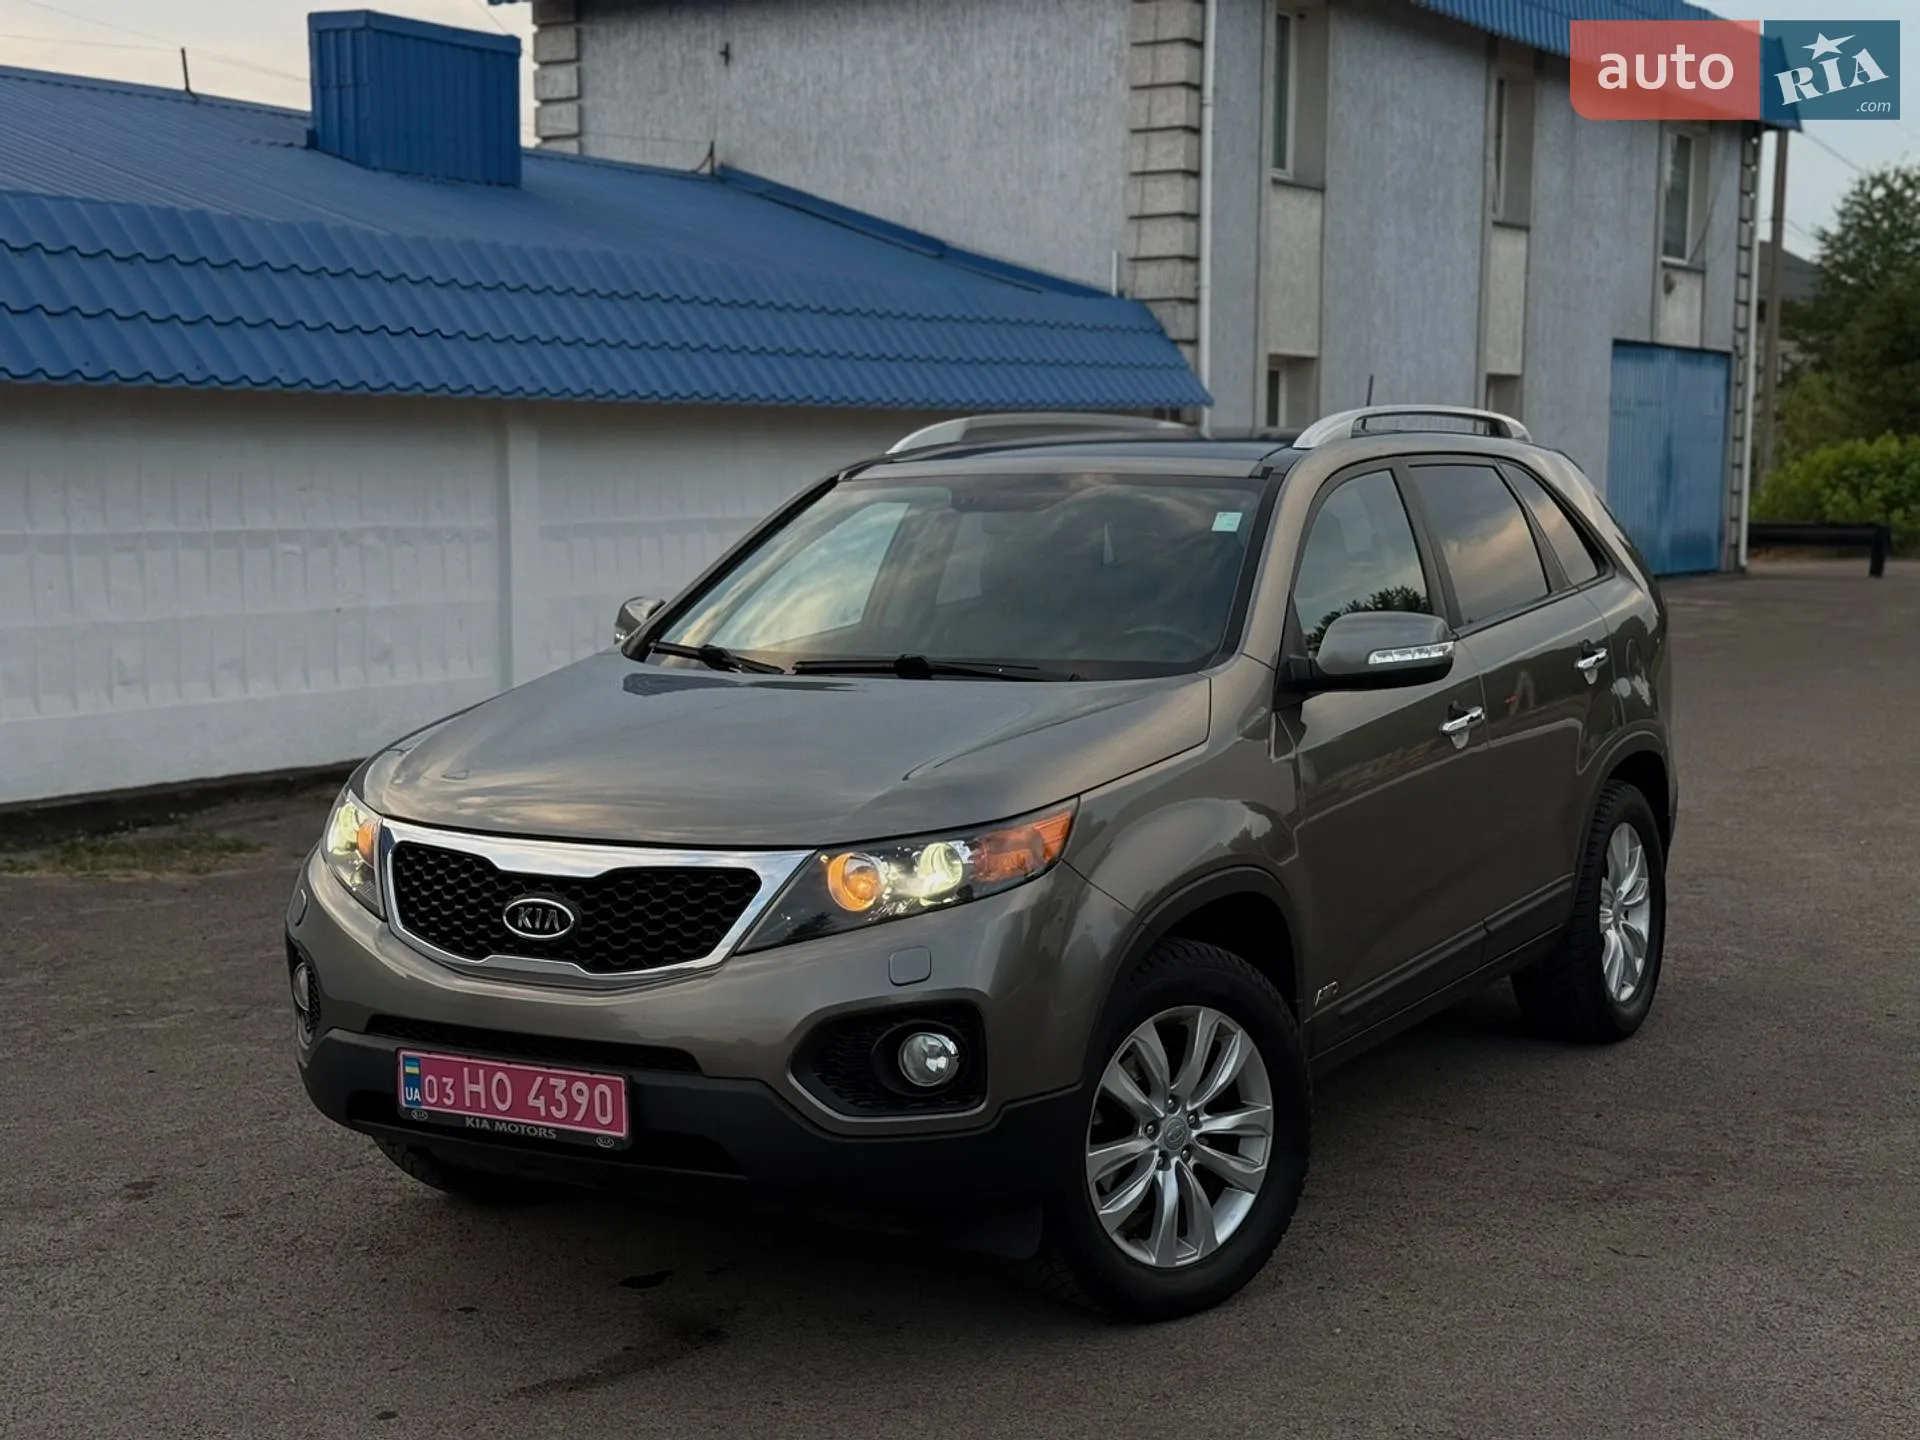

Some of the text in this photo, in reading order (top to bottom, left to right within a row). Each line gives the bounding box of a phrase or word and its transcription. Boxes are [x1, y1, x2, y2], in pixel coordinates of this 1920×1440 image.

[518, 906, 560, 931] KIA
[404, 1087, 421, 1102] UA
[424, 1074, 455, 1106] 03
[527, 1076, 614, 1125] 4390
[465, 1116, 557, 1139] KIA MOTORS
